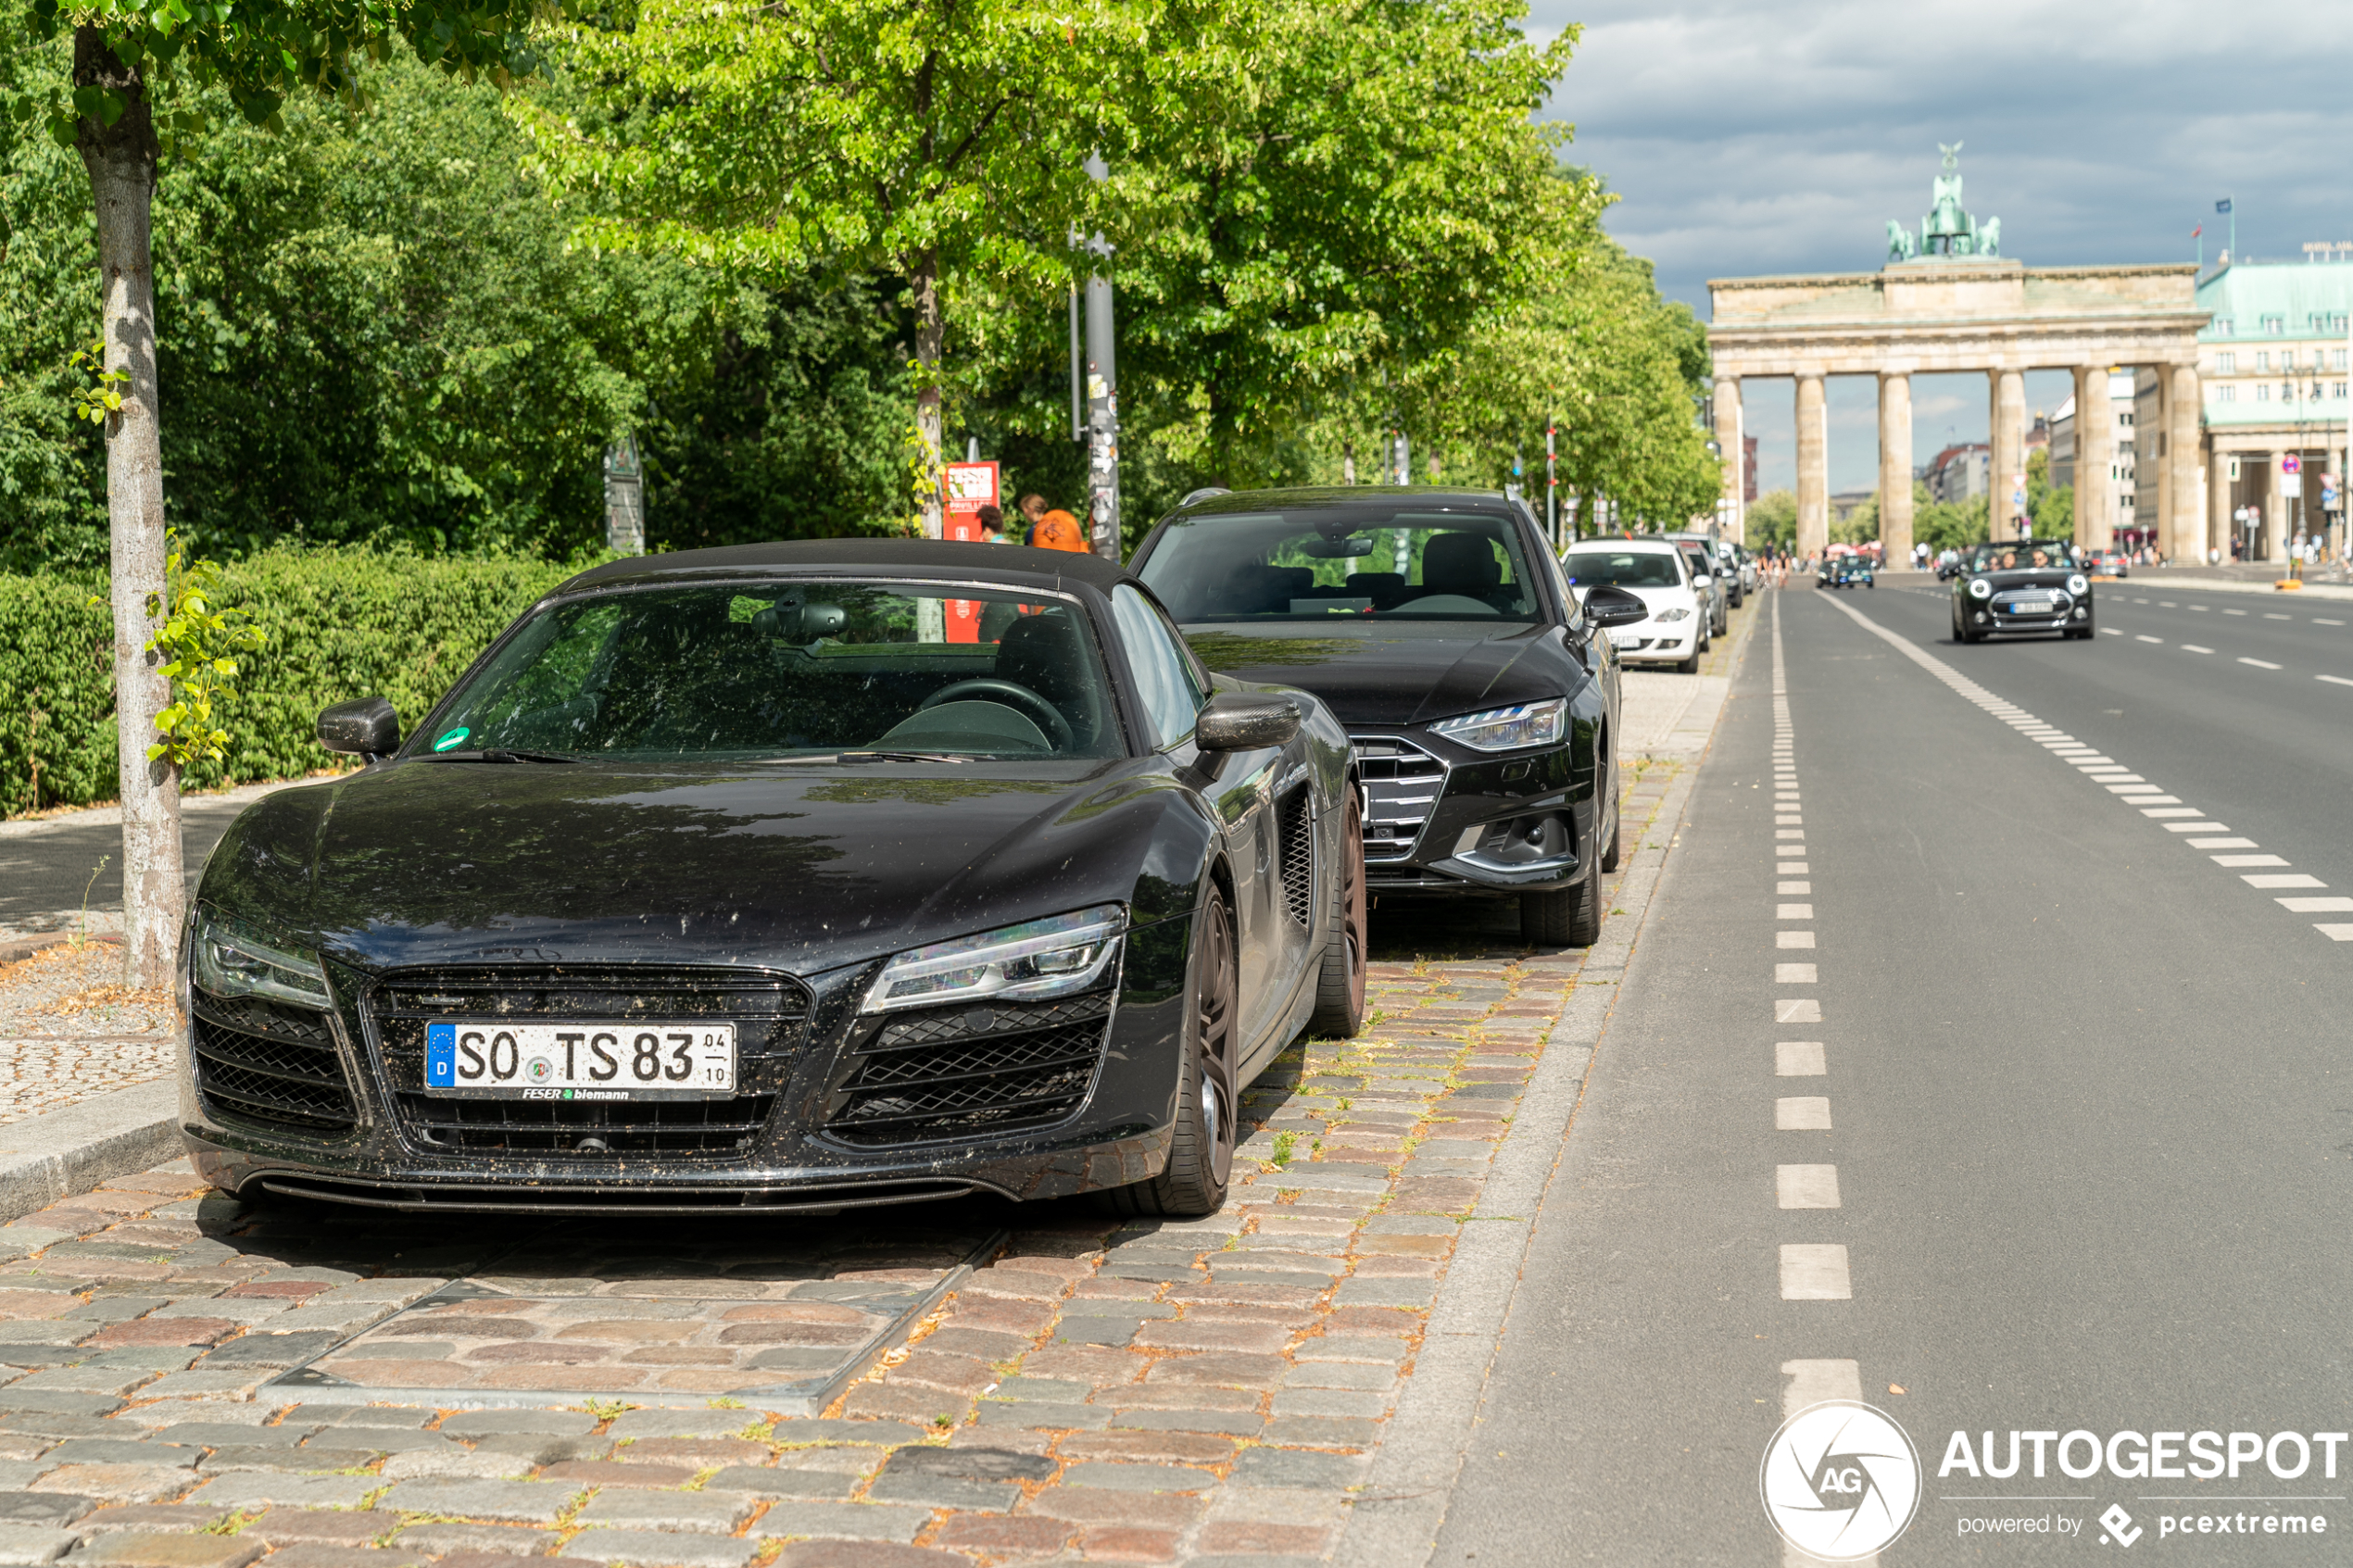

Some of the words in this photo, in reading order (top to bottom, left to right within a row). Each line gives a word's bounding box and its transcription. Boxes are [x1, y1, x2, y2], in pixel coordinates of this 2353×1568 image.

[704, 1034, 725, 1047] 04
[457, 1030, 520, 1081] SO
[436, 1061, 448, 1076] D
[706, 1067, 725, 1082] 10
[522, 1087, 562, 1100] FESER
[573, 1088, 630, 1100] biemann
